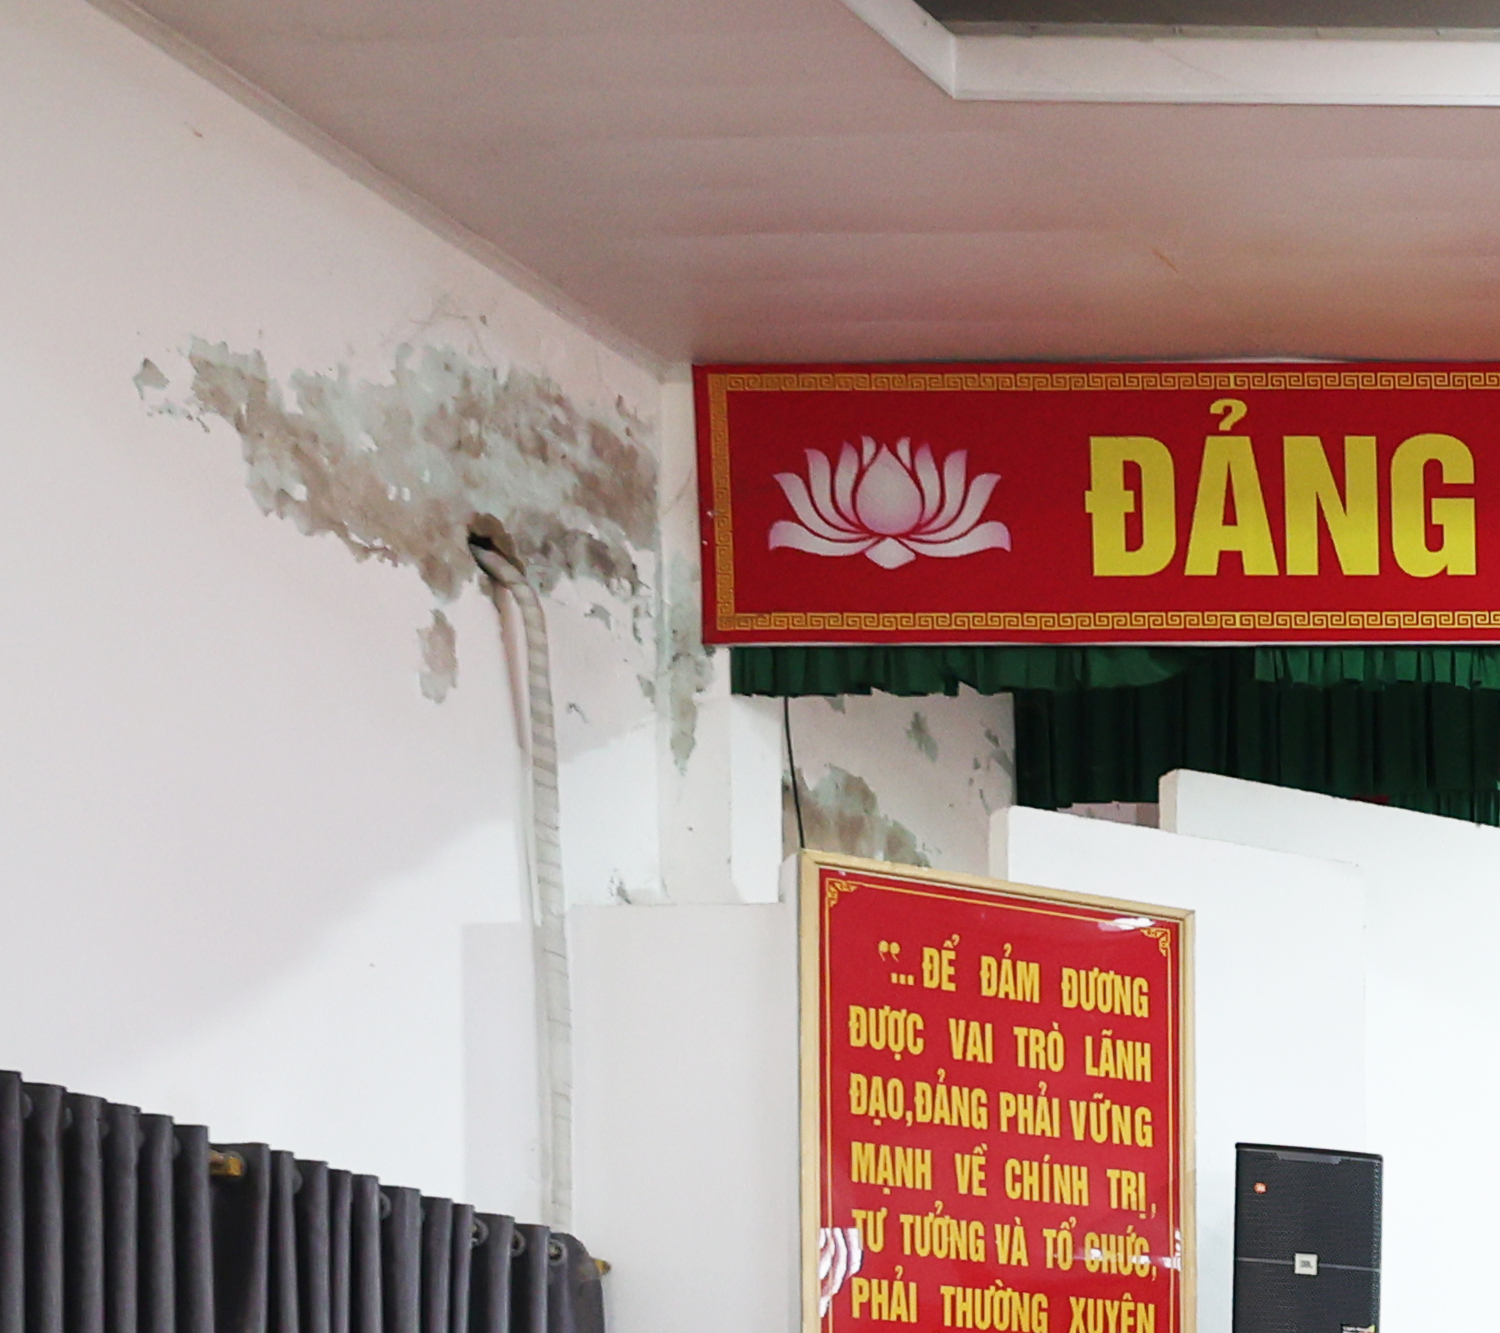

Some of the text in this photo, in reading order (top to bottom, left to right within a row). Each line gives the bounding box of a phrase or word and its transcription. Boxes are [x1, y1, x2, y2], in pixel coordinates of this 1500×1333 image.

[1086, 400, 1476, 577] ĐẢNG
[980, 944, 1039, 1003] ĐẢM
[1061, 968, 1148, 1017] ĐƯƠNG
[849, 1006, 1151, 1082] ĐƯỢC VAI TRÒ LÃNH
[1000, 1082, 1060, 1137] PHẢI
[1070, 1093, 1152, 1147] VỮNG
[852, 1142, 1156, 1218] MẠNH VỀ CHÍNH TRỊ,
